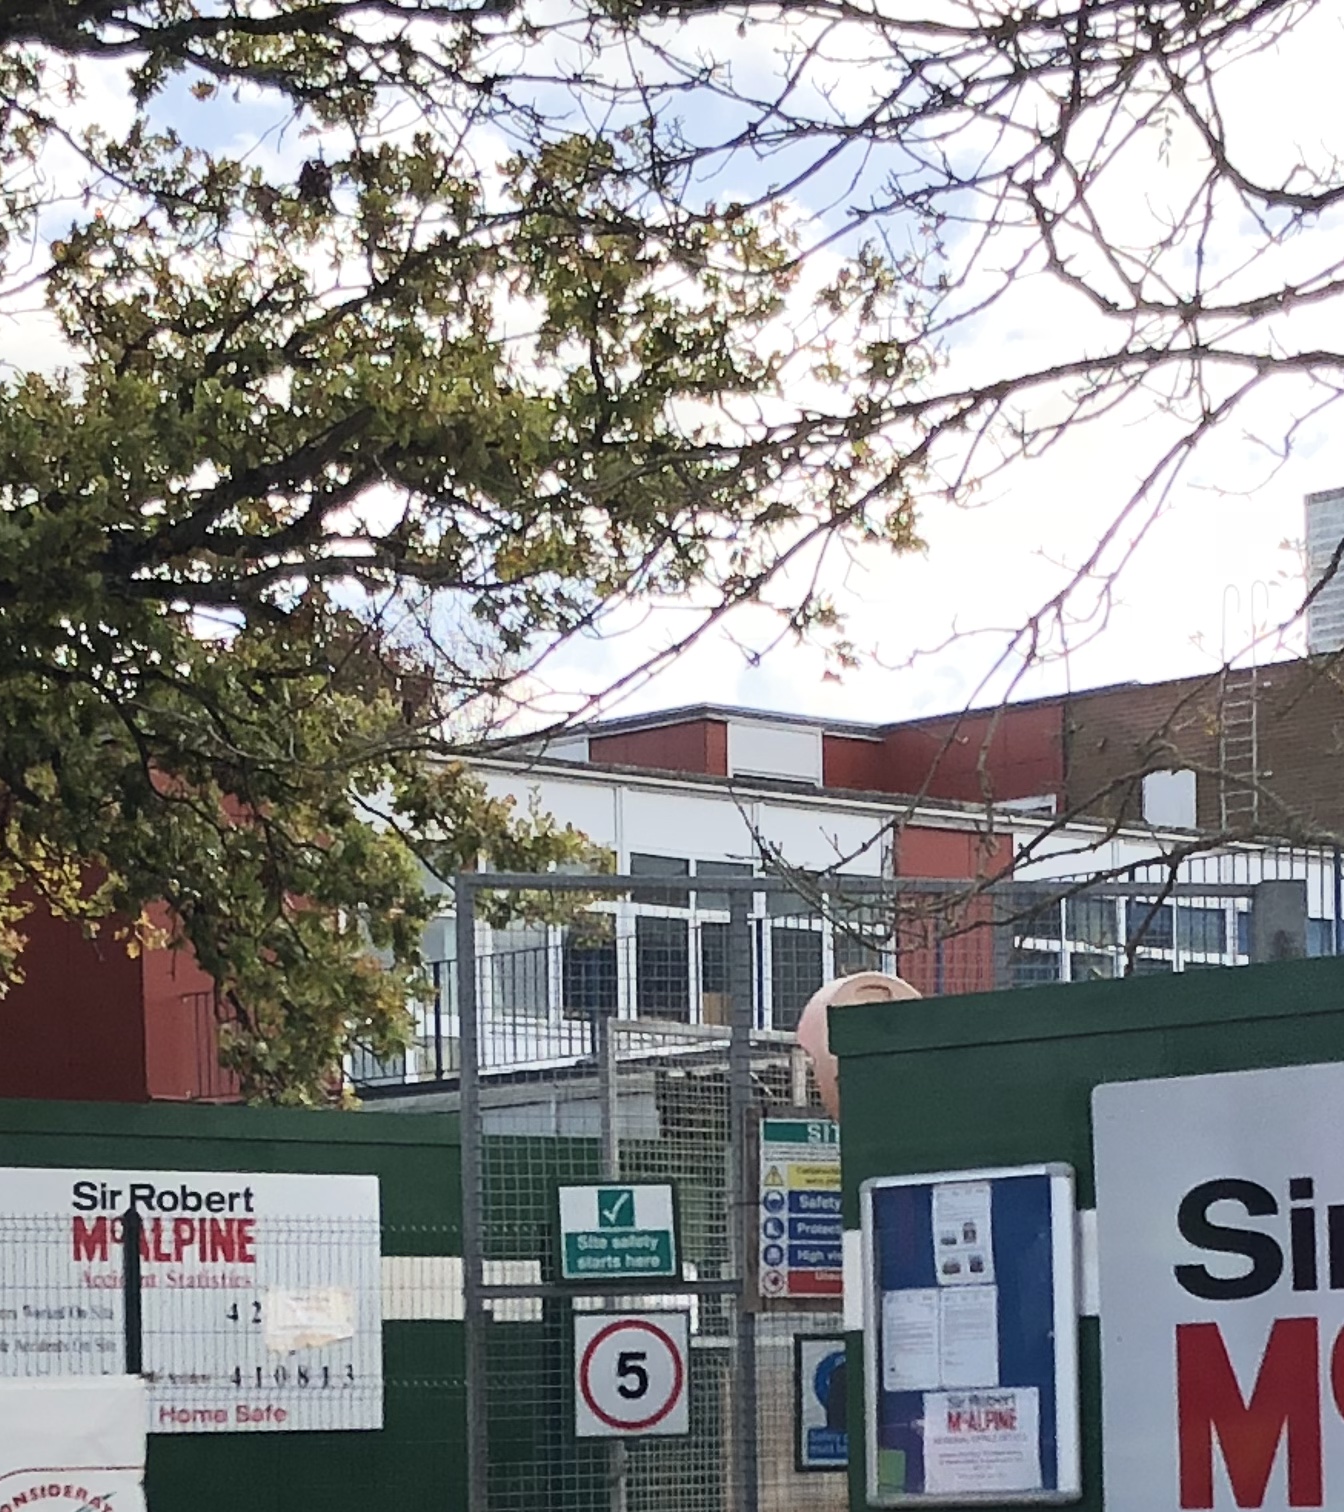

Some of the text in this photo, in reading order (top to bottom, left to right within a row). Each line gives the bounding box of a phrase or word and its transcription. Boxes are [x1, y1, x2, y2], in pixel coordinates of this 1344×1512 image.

[72, 1181, 254, 1212] Sir Robert
[799, 1194, 842, 1212] Safety
[577, 1234, 659, 1251] Site safety
[577, 1253, 660, 1270] starts here
[166, 1269, 252, 1290] Statistics
[616, 1352, 649, 1400] 5
[159, 1405, 288, 1424] Home Safe
